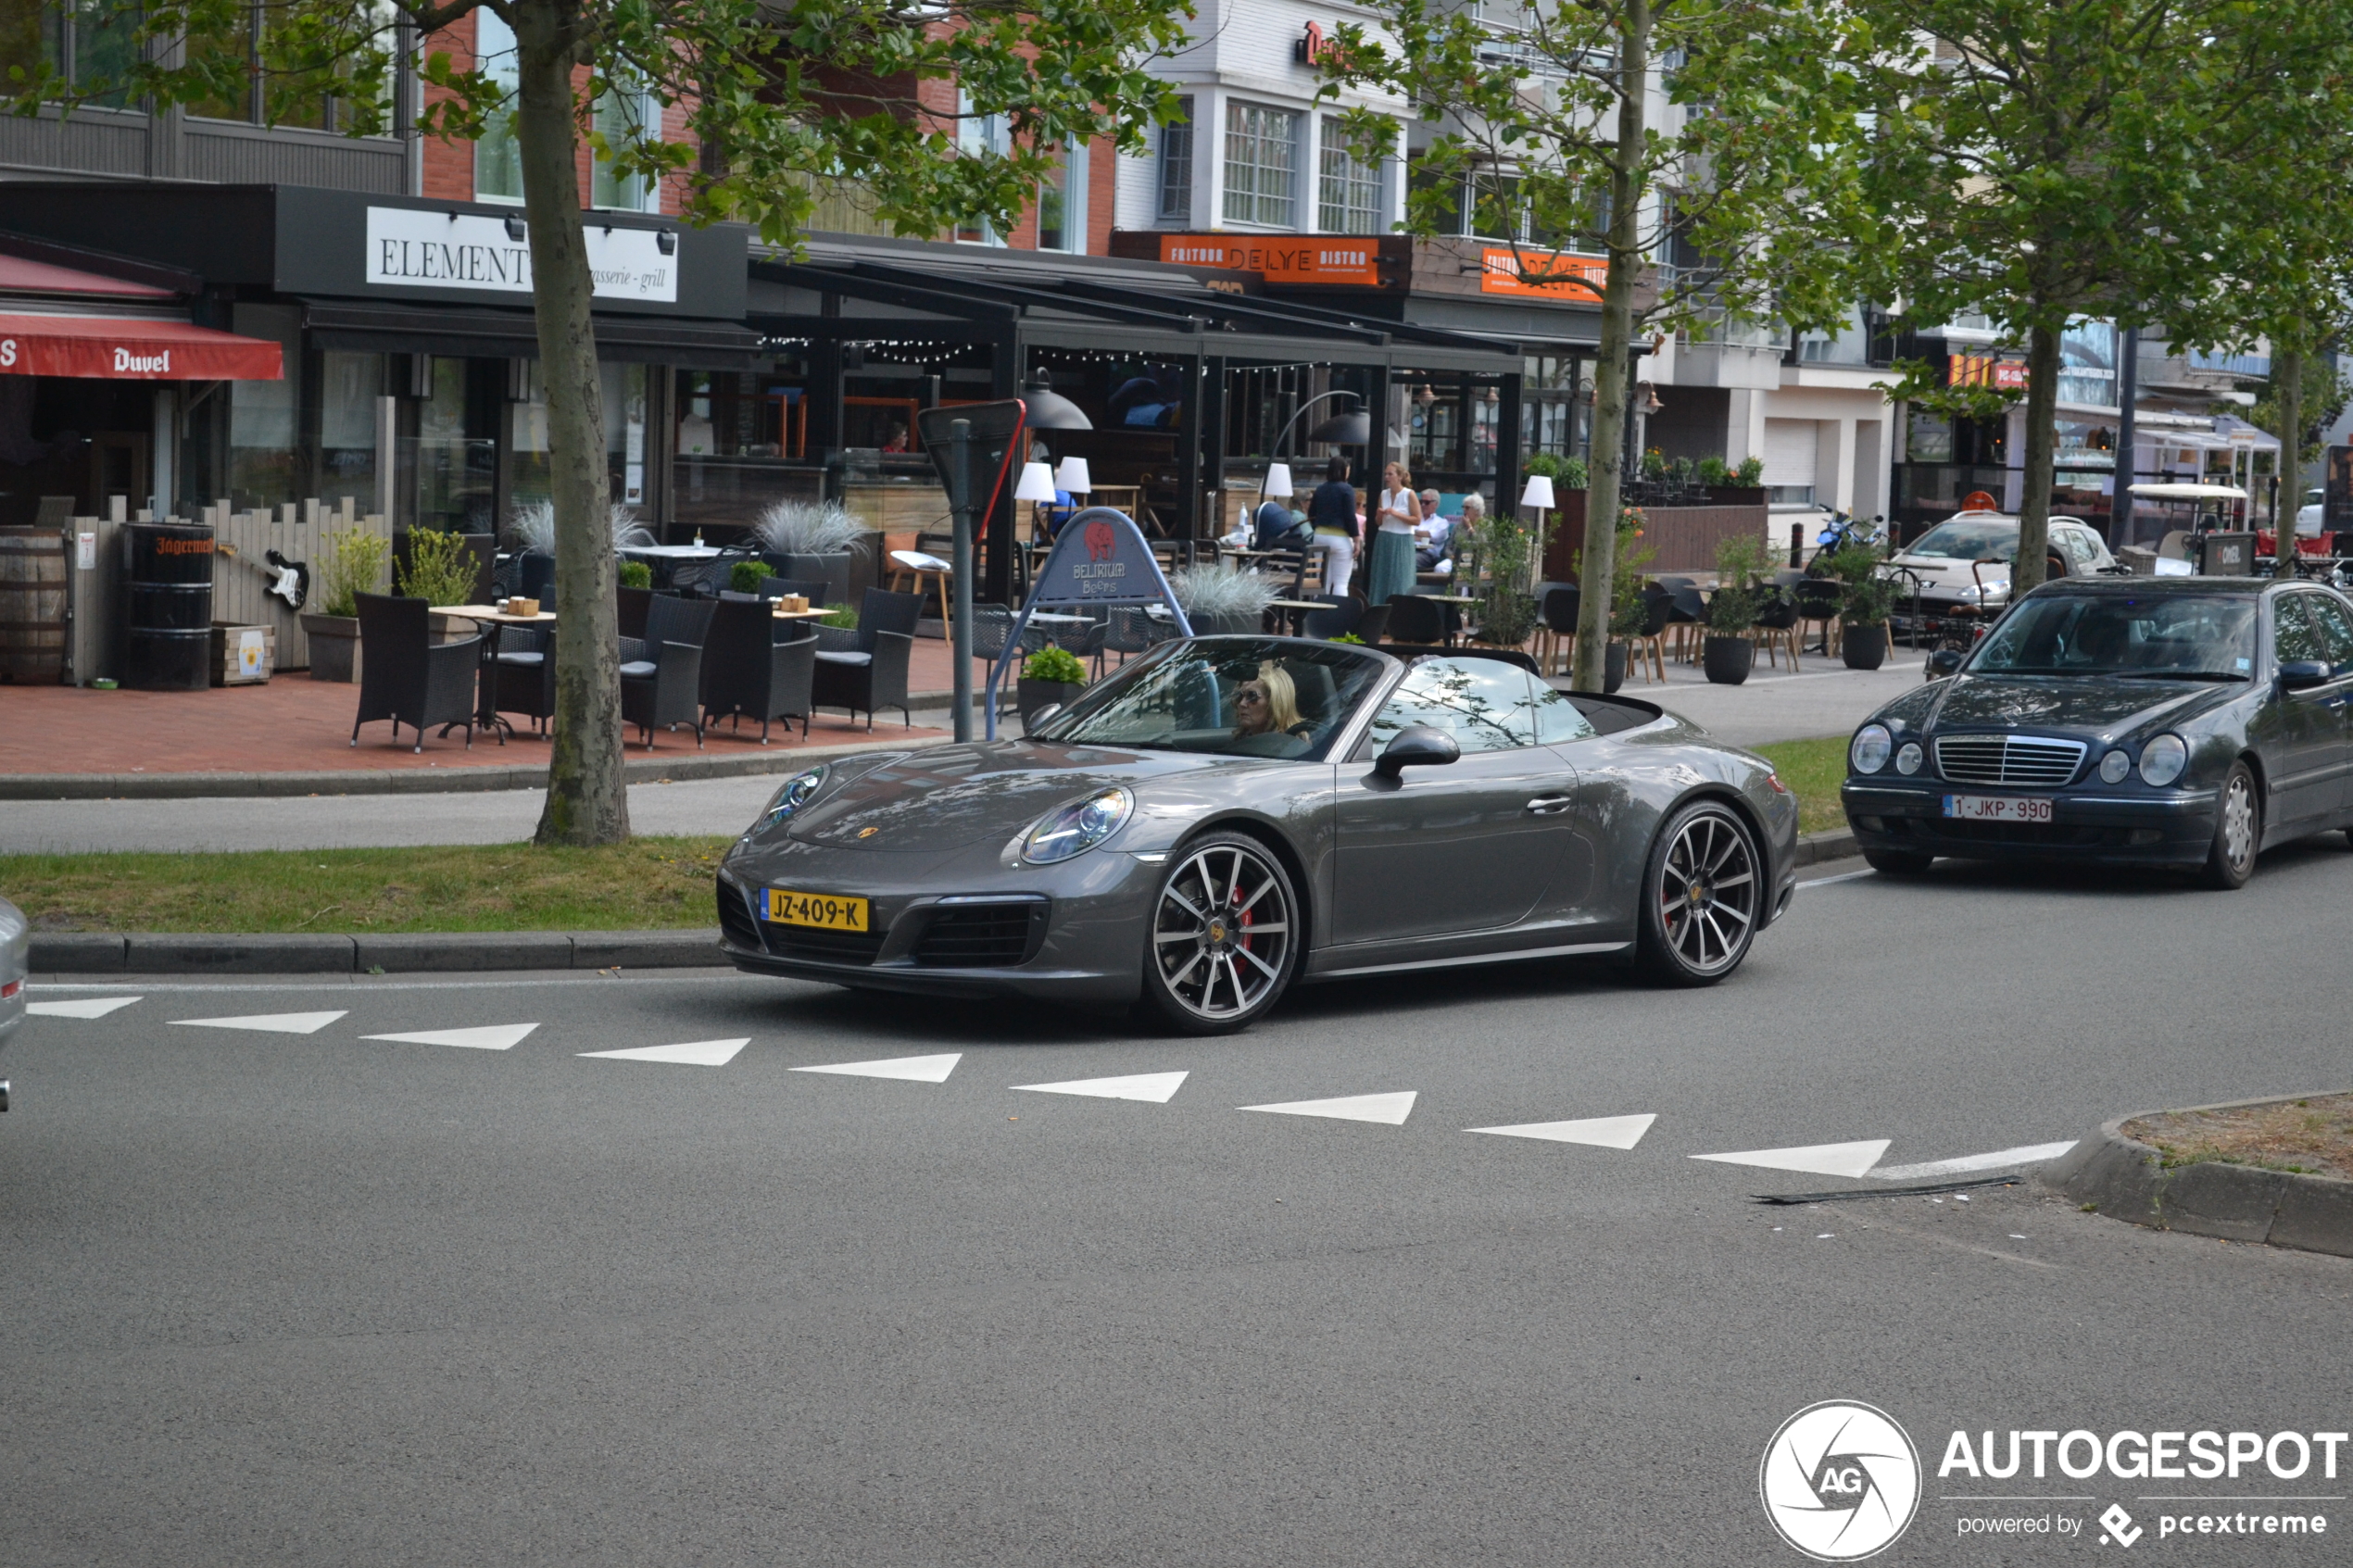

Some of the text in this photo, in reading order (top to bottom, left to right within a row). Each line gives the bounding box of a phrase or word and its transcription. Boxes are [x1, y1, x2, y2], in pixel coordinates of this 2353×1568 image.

[380, 238, 533, 284] ELEMENT
[1171, 247, 1224, 262] FRITUUR
[1229, 248, 1313, 271] DELYE
[1319, 250, 1366, 266] BISTRO
[639, 268, 665, 294] grill
[114, 346, 170, 372] Duvel
[1073, 562, 1126, 579] DELIRIUM
[1082, 580, 1117, 594] Beers
[774, 894, 859, 927] JZ-409-K
